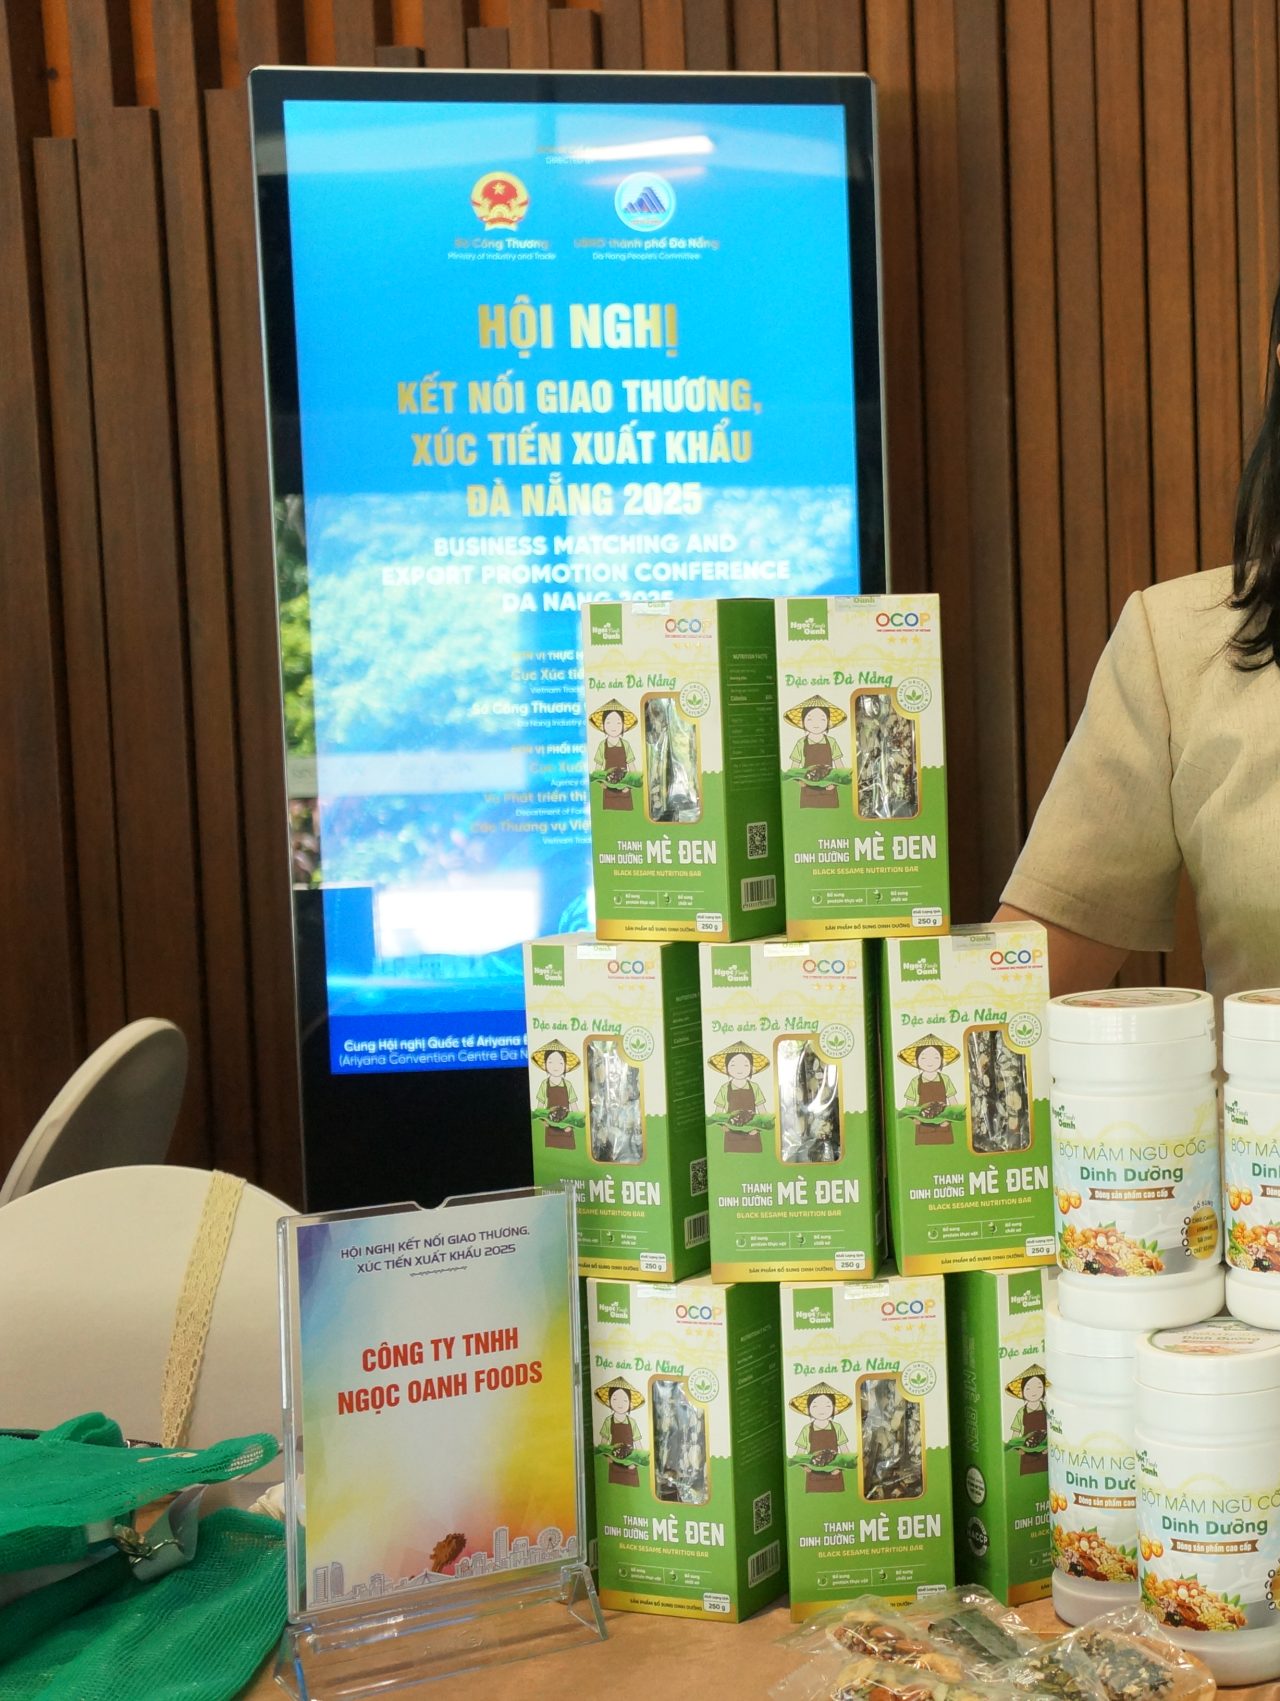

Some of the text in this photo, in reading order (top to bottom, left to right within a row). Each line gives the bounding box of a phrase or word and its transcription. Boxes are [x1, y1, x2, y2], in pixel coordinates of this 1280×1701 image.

[478, 294, 678, 358] HỘI NGHỊ
[396, 369, 762, 414] KẾT NỐI GIAO THƯƠNG,
[411, 417, 752, 466] XÚC TIẾN XUẤT KHẨU
[466, 472, 704, 518] ĐÀ NẴNG 2025
[434, 532, 738, 558] BUSINESS MATCHING AND
[381, 560, 791, 587] EXPORT PROMOTION CONFERENCE
[502, 592, 537, 612] DA
[876, 612, 931, 627] OCOP
[833, 671, 854, 686] Đà
[646, 834, 718, 865] MÈ ĐEN
[794, 830, 936, 864] DINH DƯỠNG MÈ ĐEN
[818, 838, 849, 850] THANH
[812, 865, 919, 876] BLACK SESAME NUTRITION BAR
[990, 949, 1043, 965] OCOP
[339, 1049, 517, 1067] (Ariyana Convention Centre Da
[344, 1034, 521, 1054] Cung Hội nghị Quốc tế Ariyana
[1059, 1136, 1207, 1161] BỘT MẦM NGŨ CỐC
[1231, 1137, 1251, 1157] BỘT
[969, 1164, 1049, 1196] MÈ ĐEN
[1080, 1165, 1183, 1183] Dinh Dưỡng
[589, 1174, 661, 1206] MÈ ĐEN
[777, 1175, 860, 1206] MÈ ĐEN
[341, 1246, 362, 1260] HỘI
[365, 1243, 396, 1258] NGHỊ
[398, 1236, 421, 1252] KẾT
[424, 1233, 445, 1250] NỐI
[447, 1231, 477, 1246] GIAO
[357, 1243, 516, 1275] XÚC TIẾN XUẤT KHẨU 2025
[881, 1299, 936, 1316] OCOP
[362, 1327, 519, 1373] CÔNG TY TNHH
[338, 1360, 543, 1415] NGỌC OANH FOODS
[652, 1513, 726, 1548] MÈ ĐEN
[859, 1511, 941, 1543] MÈ ĐEN
[1162, 1515, 1268, 1536] Dinh Dưỡng
